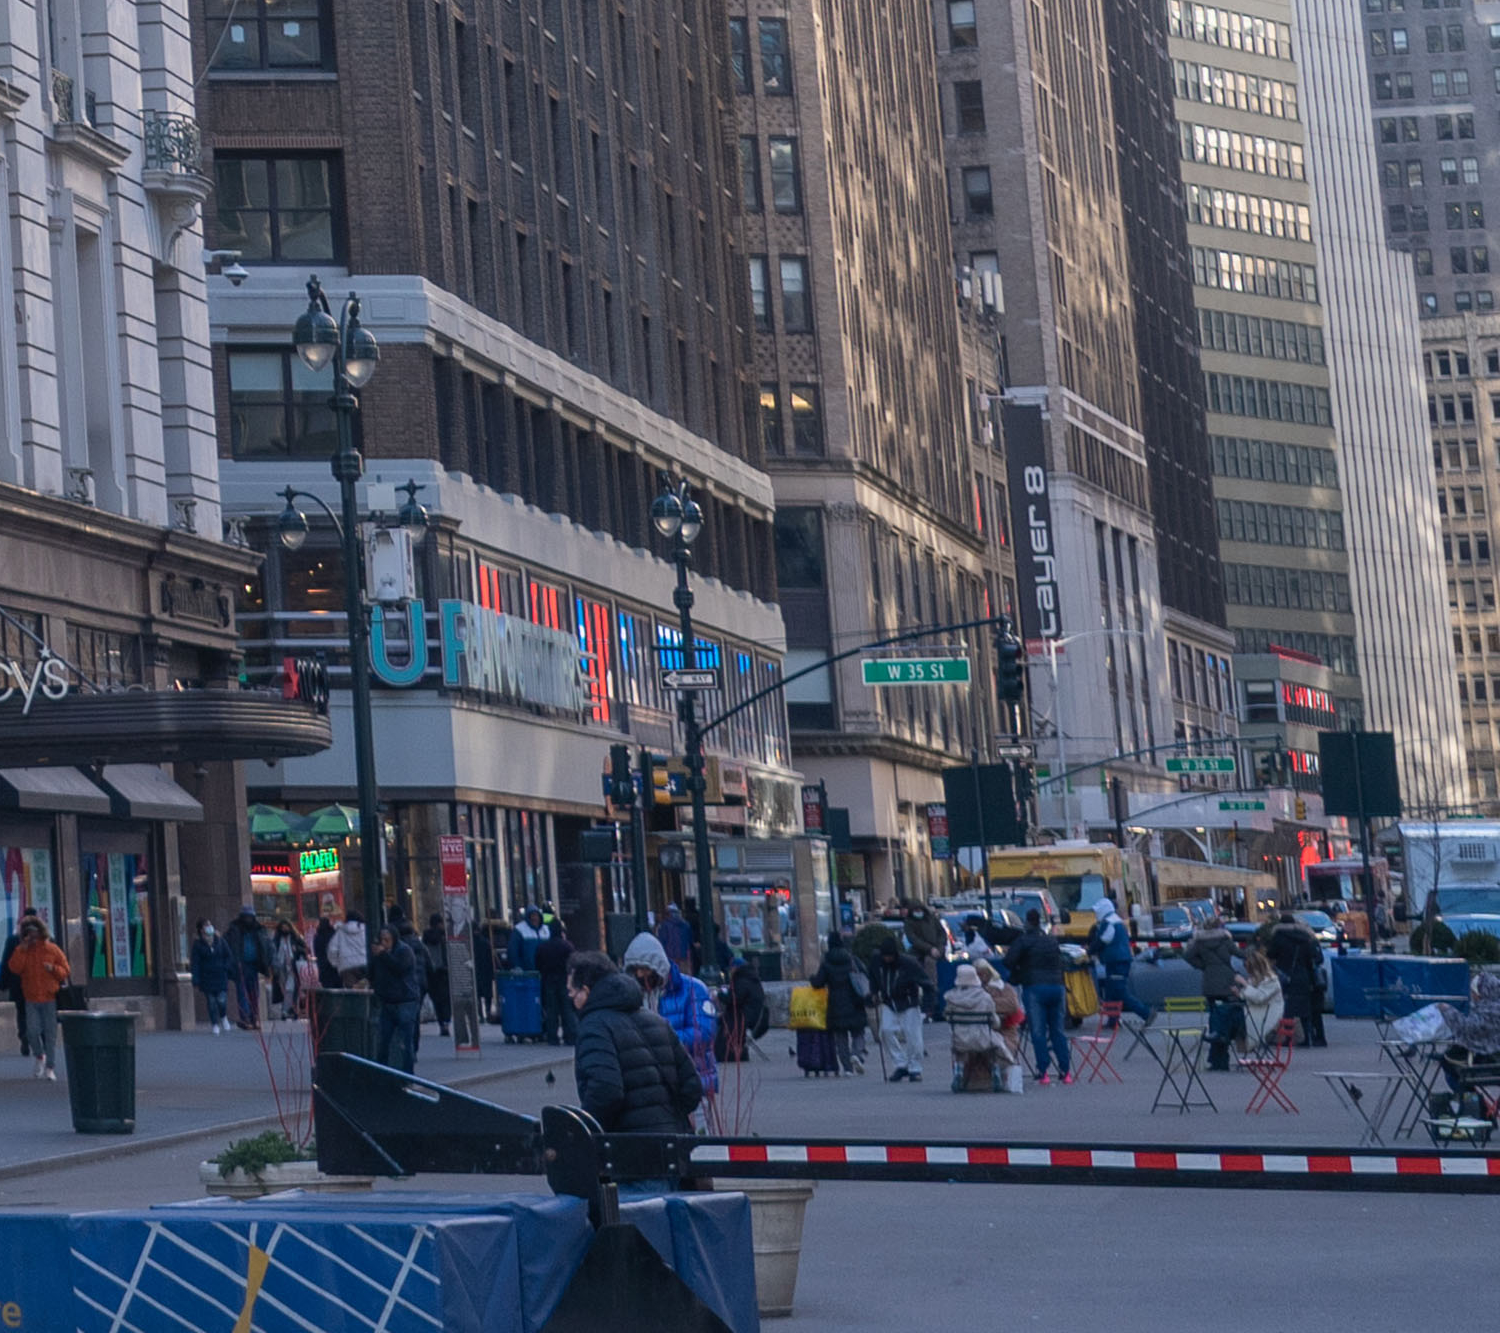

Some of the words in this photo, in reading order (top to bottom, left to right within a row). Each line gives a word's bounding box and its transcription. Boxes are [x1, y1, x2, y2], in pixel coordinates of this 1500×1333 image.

[888, 665, 901, 679] W
[908, 664, 924, 679] 35
[930, 663, 944, 679] St
[1181, 760, 1190, 770] W
